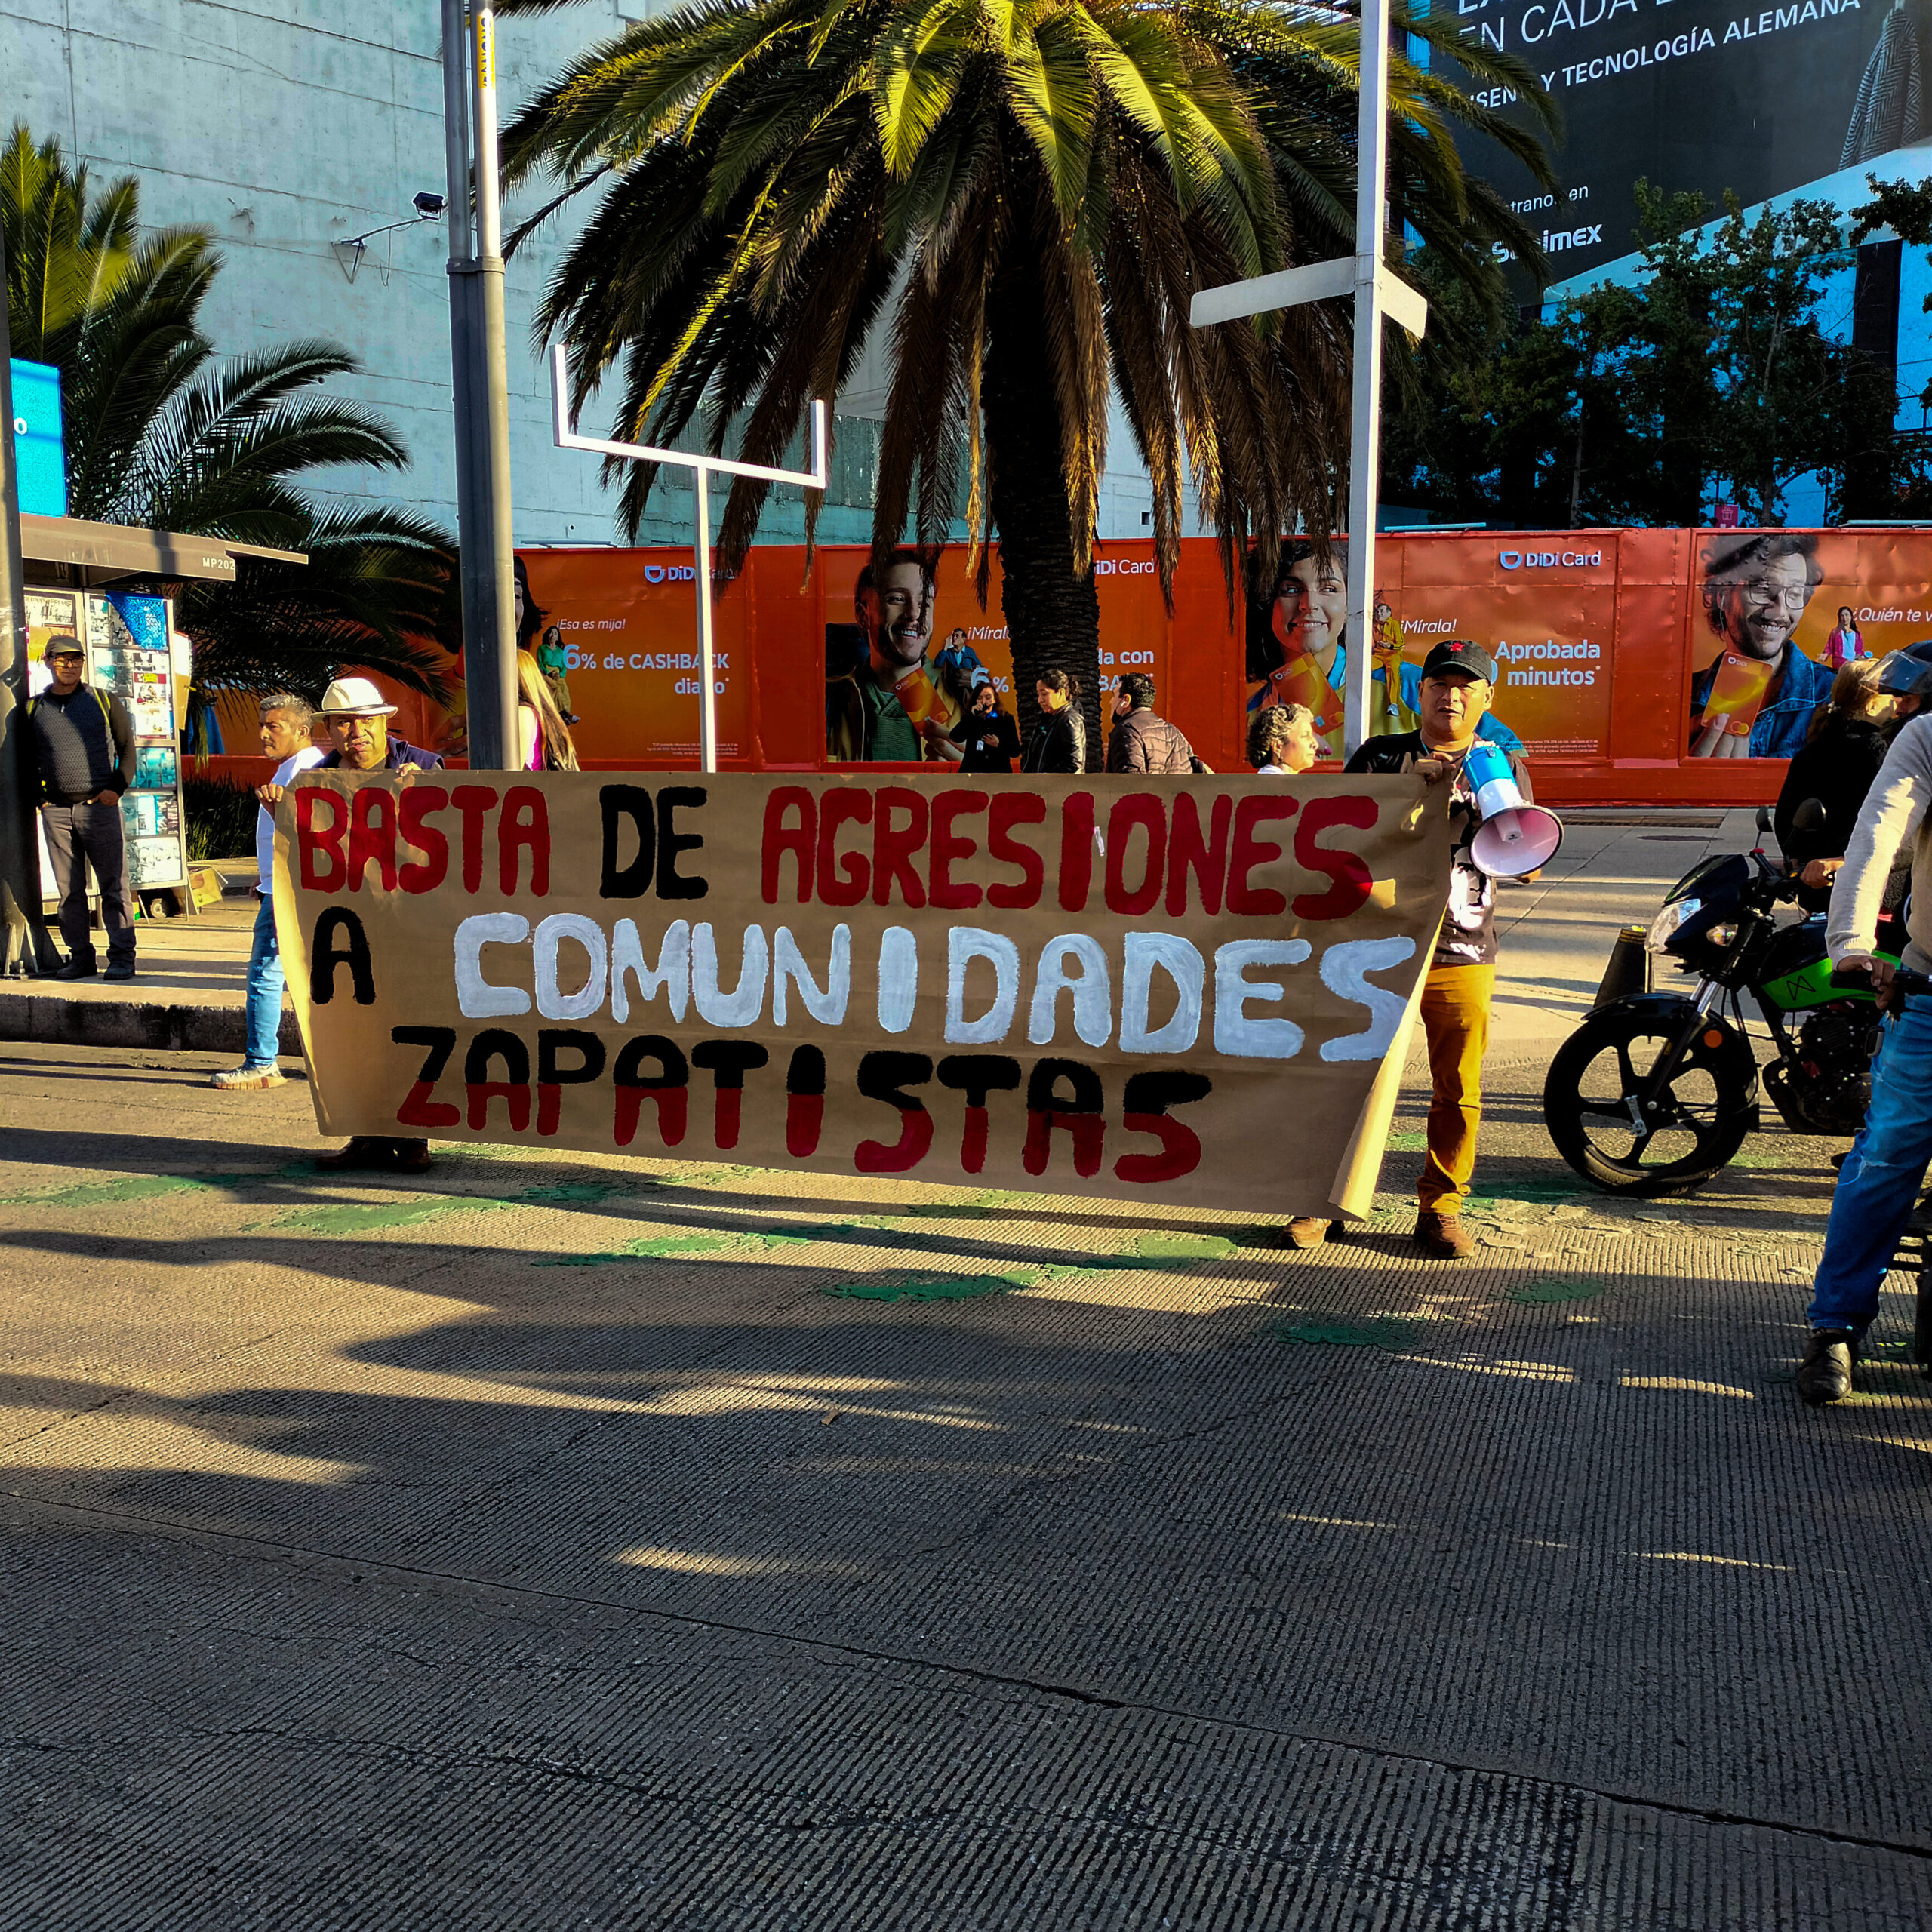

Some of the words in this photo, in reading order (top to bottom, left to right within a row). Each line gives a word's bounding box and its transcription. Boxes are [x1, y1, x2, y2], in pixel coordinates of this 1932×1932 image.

[1540, 71, 1556, 92] Y
[1562, 26, 1715, 86] TECNOLOGÍA
[1723, 0, 1860, 44] ALEMANA
[1568, 186, 1589, 202] en
[1094, 559, 1116, 574] iDi
[1118, 558, 1155, 574] Card
[1526, 551, 1560, 567] DiDi
[1561, 549, 1601, 567] Card
[668, 565, 696, 580] DiD
[1907, 608, 1921, 622] te
[582, 621, 595, 629] es
[597, 618, 626, 632] mija!
[967, 625, 1010, 640] ¡Míral
[1401, 618, 1457, 634] ¡Mírala!
[1119, 651, 1154, 664] con
[1494, 639, 1601, 664] Aprobada
[603, 653, 625, 669] de
[294, 785, 551, 897] BASTA
[598, 783, 709, 900] DE
[761, 785, 1379, 921] AGRESIONES
[309, 906, 376, 1005] A
[453, 912, 1417, 1062] COMUNIDADES
[391, 1026, 1213, 1184] ZAPATISTAS
